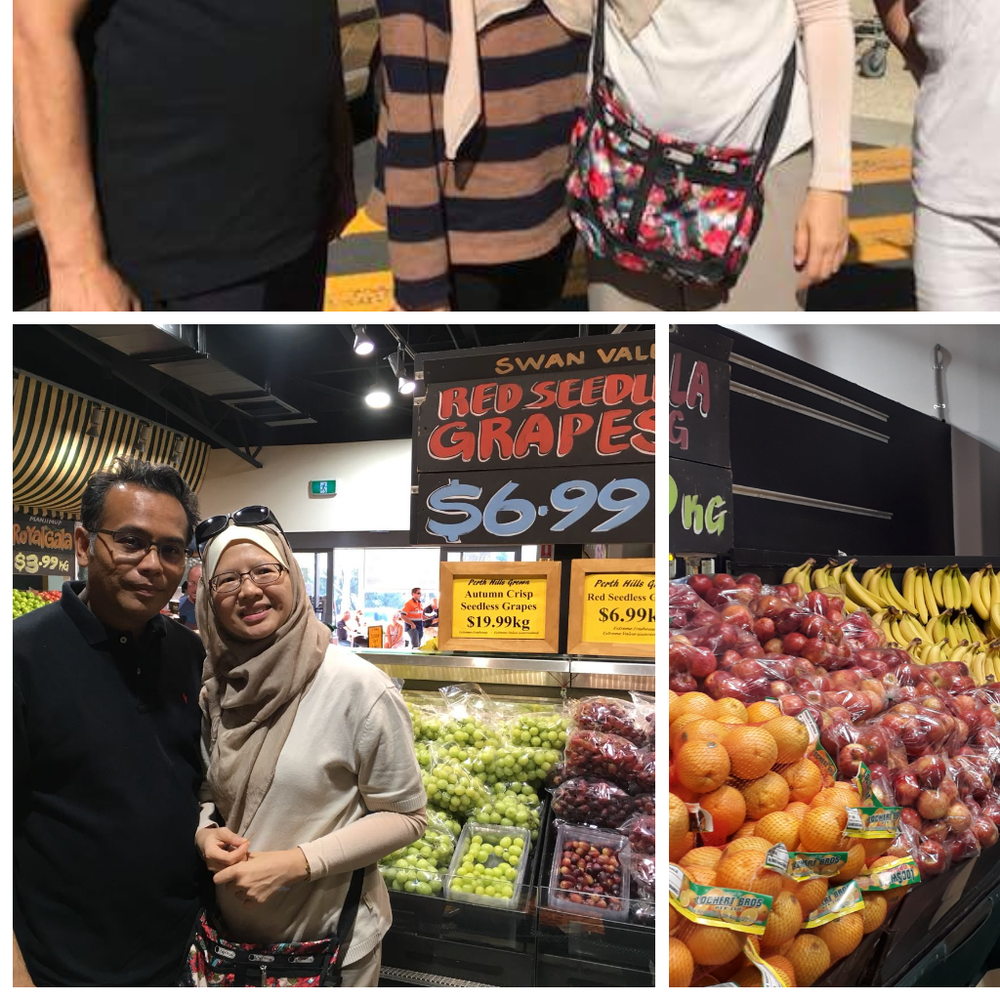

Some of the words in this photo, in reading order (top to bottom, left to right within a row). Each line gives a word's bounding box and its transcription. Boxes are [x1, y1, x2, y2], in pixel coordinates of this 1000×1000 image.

[494, 350, 586, 374] SWAN
[597, 343, 655, 364] VAL
[437, 380, 523, 421] RED
[522, 373, 655, 410] SEEDL
[427, 407, 655, 462] GRAPES
[425, 477, 651, 543] $6.99
[467, 578, 487, 586] Perth
[489, 578, 506, 586] Hills
[593, 578, 619, 588] Perth
[622, 578, 645, 588] Hills
[464, 589, 504, 599] Autumn
[506, 589, 534, 600] Crisp
[587, 592, 606, 601] Red
[607, 592, 648, 602] Seedless
[460, 602, 500, 611] Seedless
[501, 602, 538, 613] Grapes
[466, 615, 530, 631] $19.99kg
[737, 896, 764, 908] BROS
